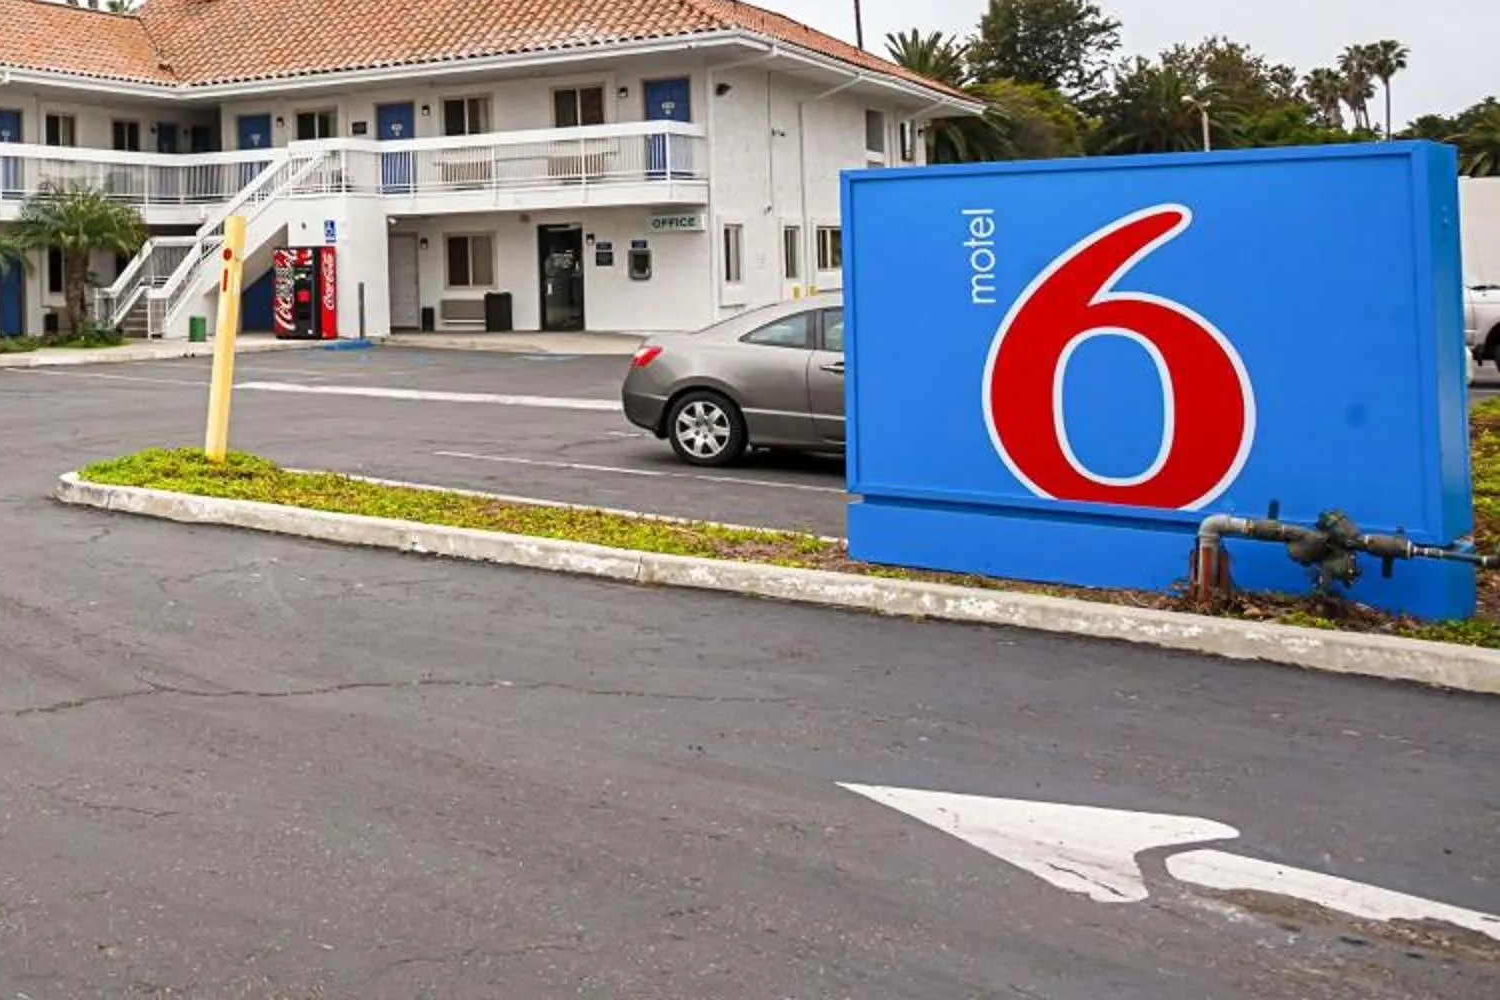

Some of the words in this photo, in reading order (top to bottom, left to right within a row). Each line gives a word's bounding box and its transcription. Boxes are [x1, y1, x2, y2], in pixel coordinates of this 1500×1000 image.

[652, 217, 696, 229] OFFICE
[321, 252, 335, 311] Coca-Cola
[962, 208, 995, 304] motel
[981, 202, 1257, 511] 6
